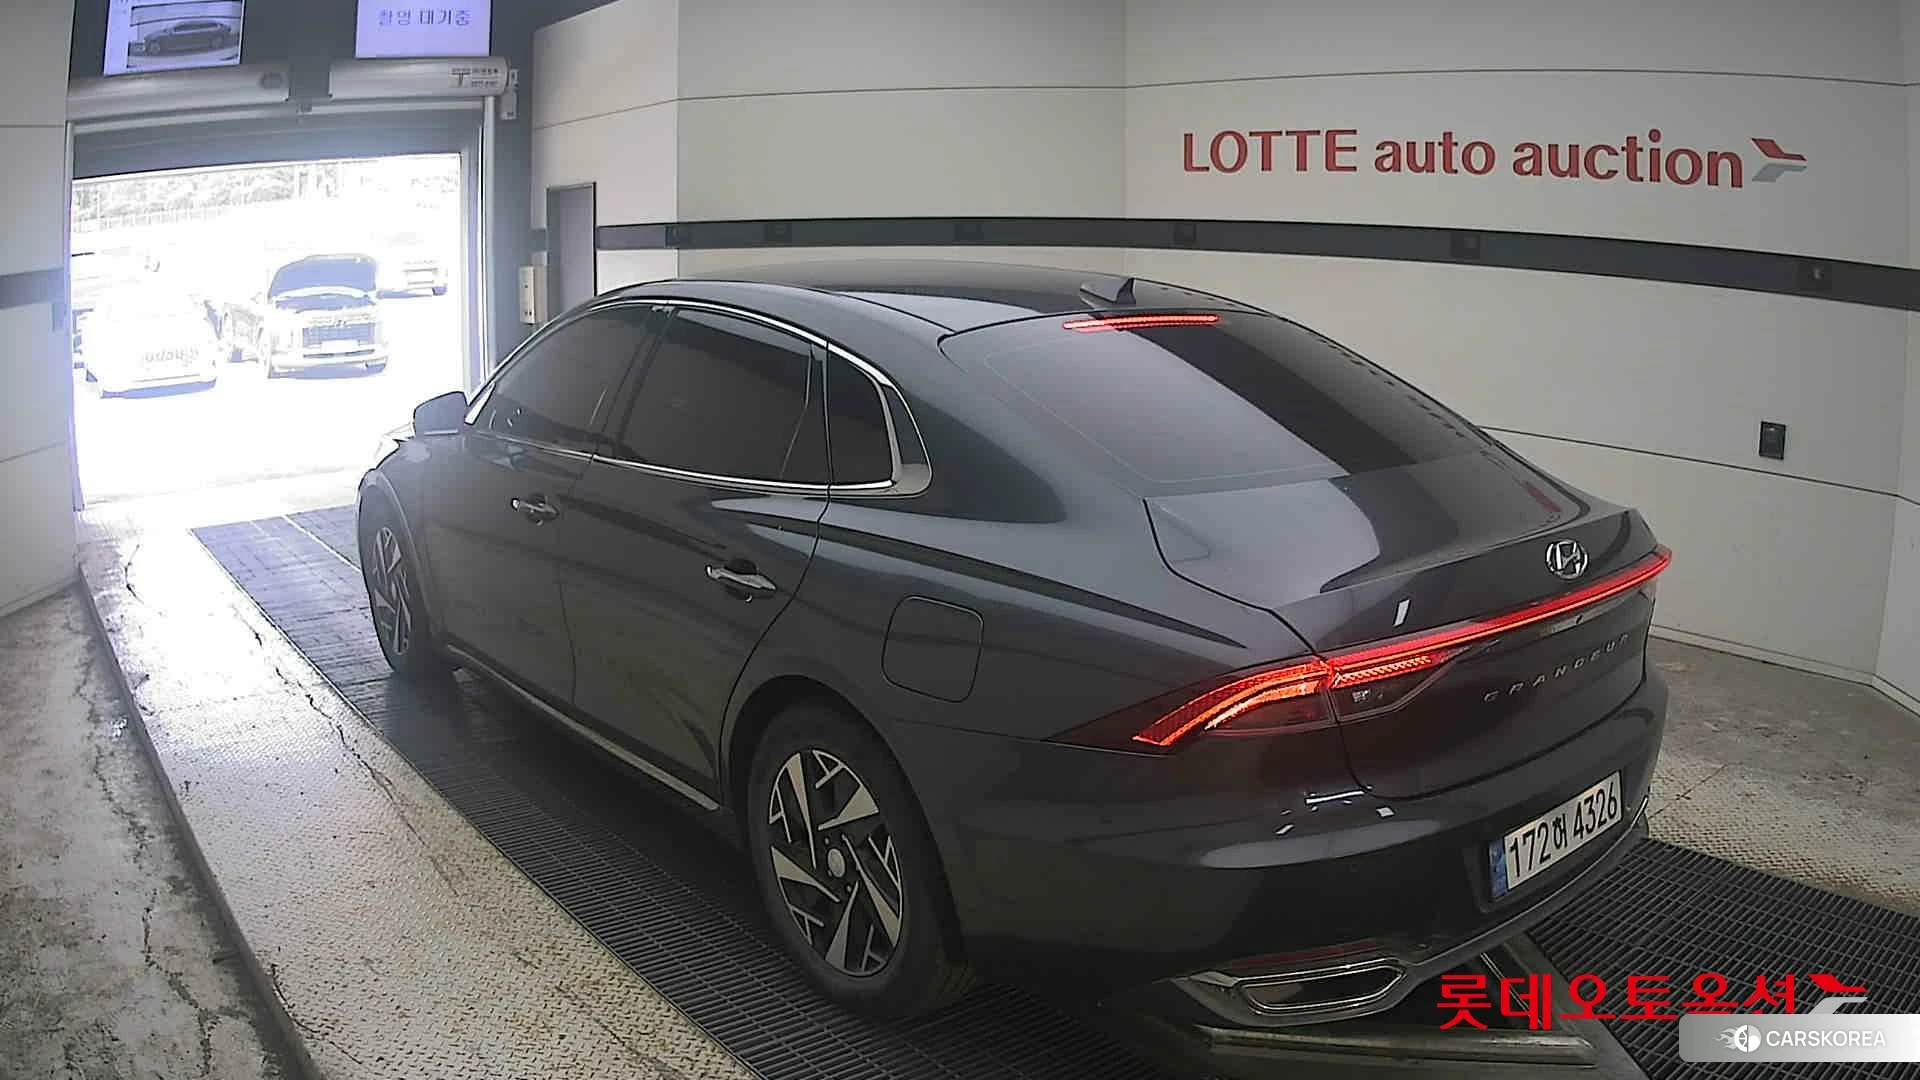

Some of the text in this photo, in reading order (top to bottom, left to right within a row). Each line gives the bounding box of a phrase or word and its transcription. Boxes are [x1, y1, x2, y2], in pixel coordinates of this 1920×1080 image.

[419, 8, 471, 26] 대기중
[1183, 128, 1744, 188] LOTTE auto auction
[1573, 781, 1618, 840] 4326
